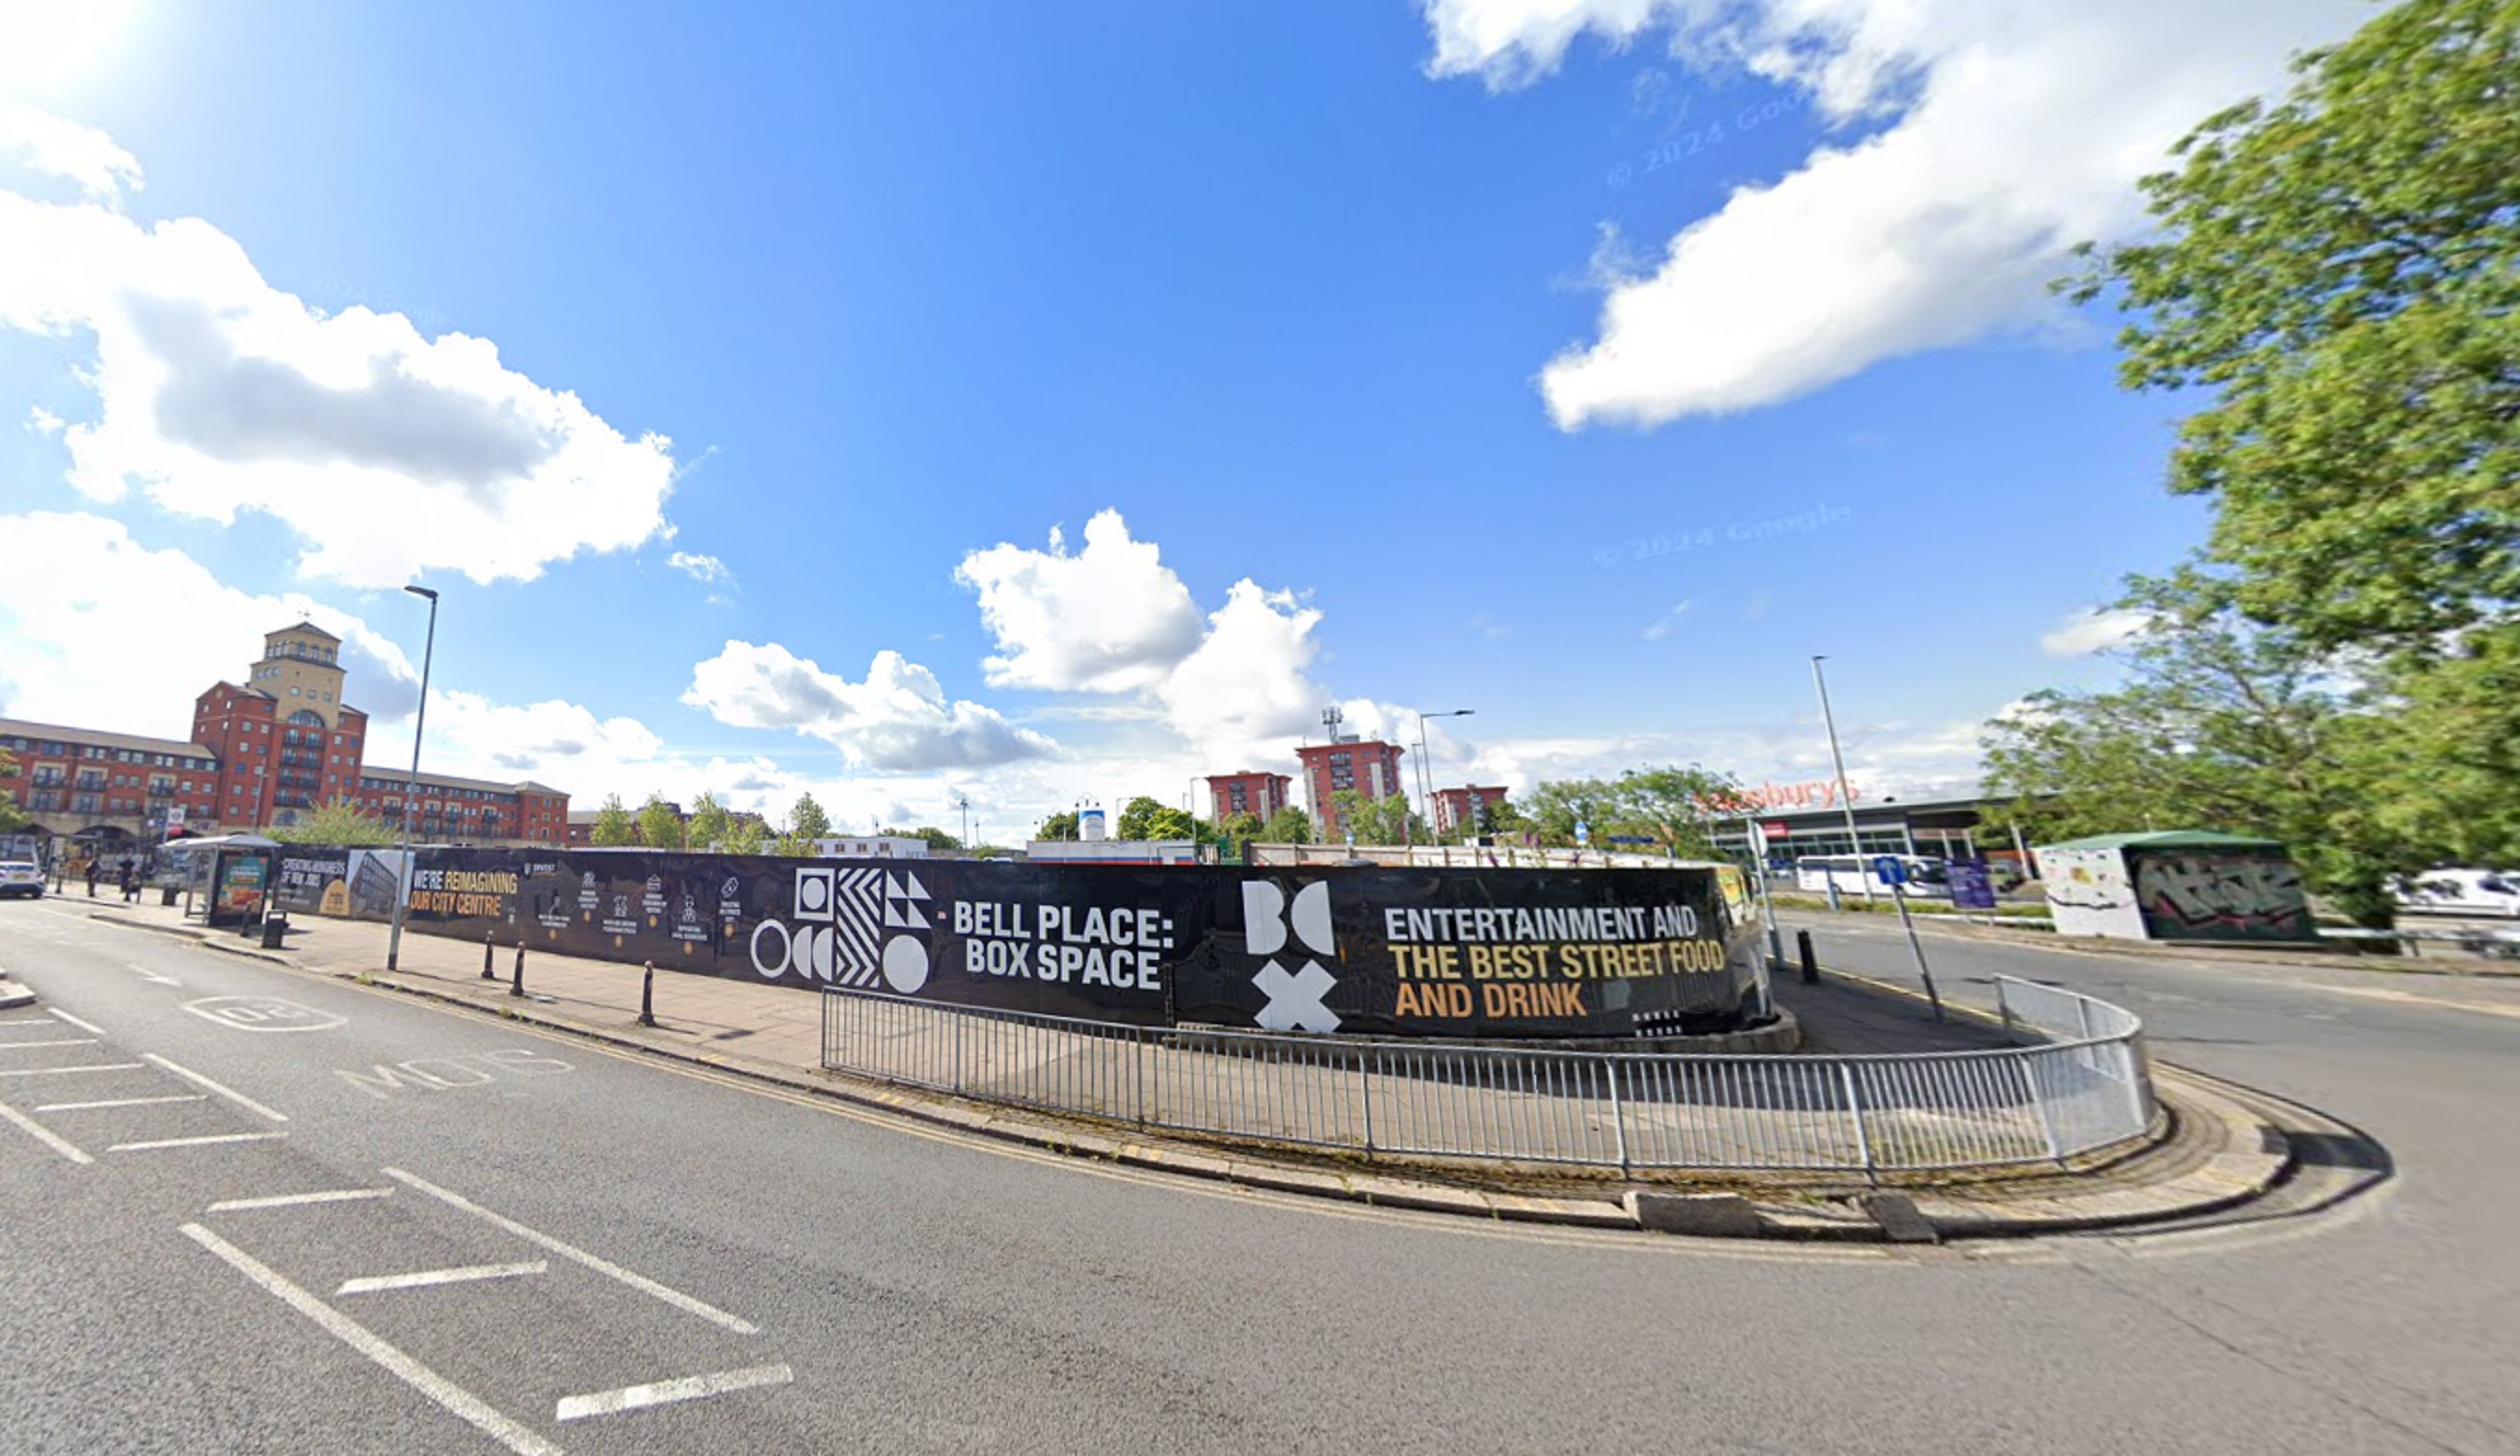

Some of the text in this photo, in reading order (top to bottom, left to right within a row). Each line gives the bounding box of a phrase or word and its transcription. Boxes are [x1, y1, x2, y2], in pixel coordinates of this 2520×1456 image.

[415, 869, 518, 893] WE'RE REIMAGINING
[410, 891, 502, 916] OUR CITY CENTRE
[954, 901, 1174, 949] BELL PLACE:
[1385, 906, 1697, 942] ENTERTAINMENT AND
[966, 938, 1161, 991] BOX SPACE
[1386, 939, 1726, 979] THE BEST STREET FOOD
[1396, 982, 1588, 1018] AND DRINK
